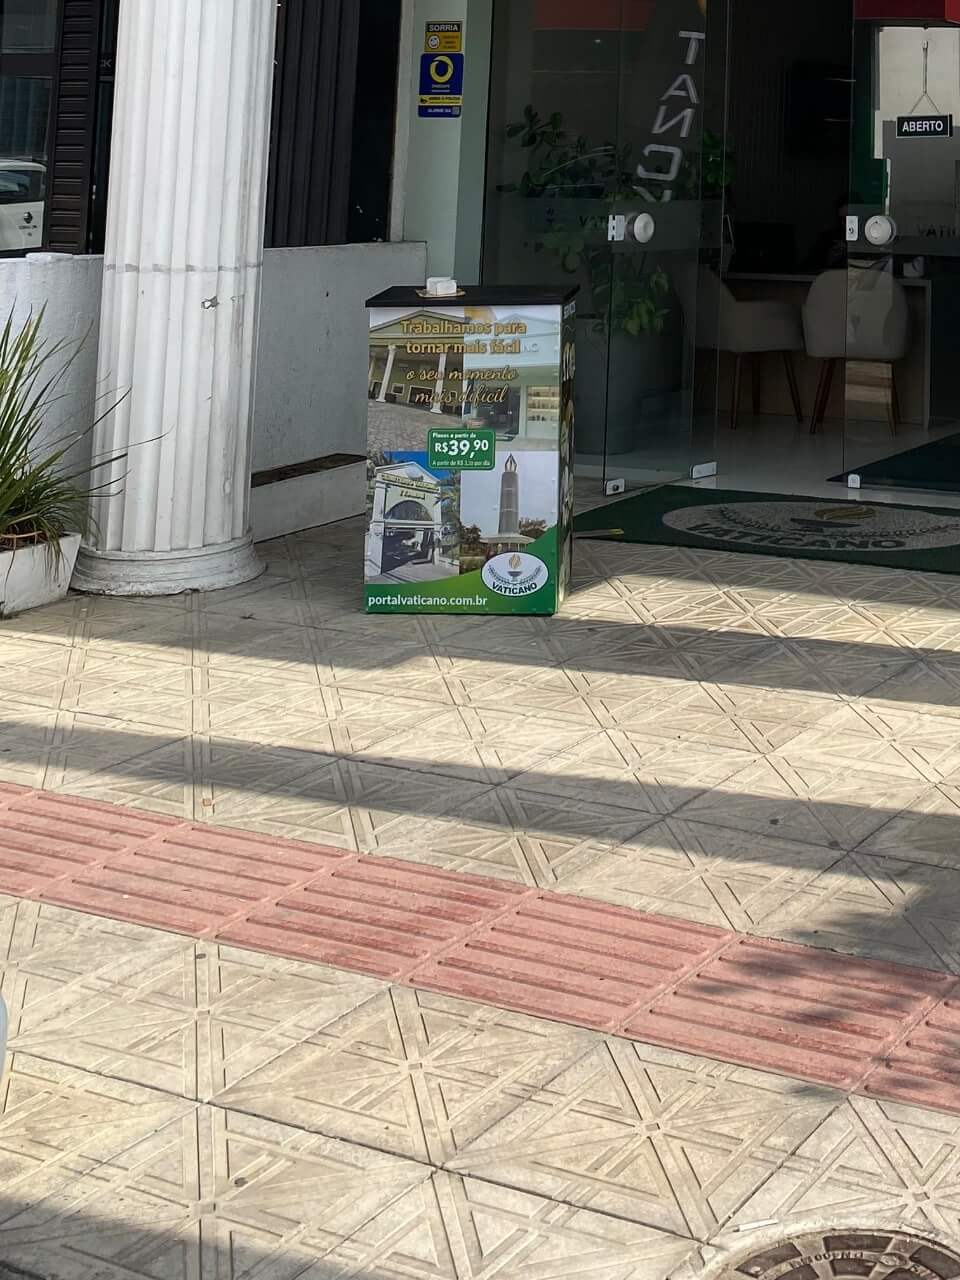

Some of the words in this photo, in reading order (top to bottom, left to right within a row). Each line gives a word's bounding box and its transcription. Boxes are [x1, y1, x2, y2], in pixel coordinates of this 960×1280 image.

[428, 24, 459, 32] SORRIA
[902, 120, 944, 132] ABERTO
[402, 320, 492, 334] Trabalhamos
[495, 321, 527, 336] para
[406, 341, 450, 353] tornar
[453, 339, 488, 353] mais
[448, 365, 518, 380] momento
[686, 524, 906, 548] VATICANO
[492, 581, 538, 594] VATICANO
[368, 595, 488, 606] portalvaticano.com.br
